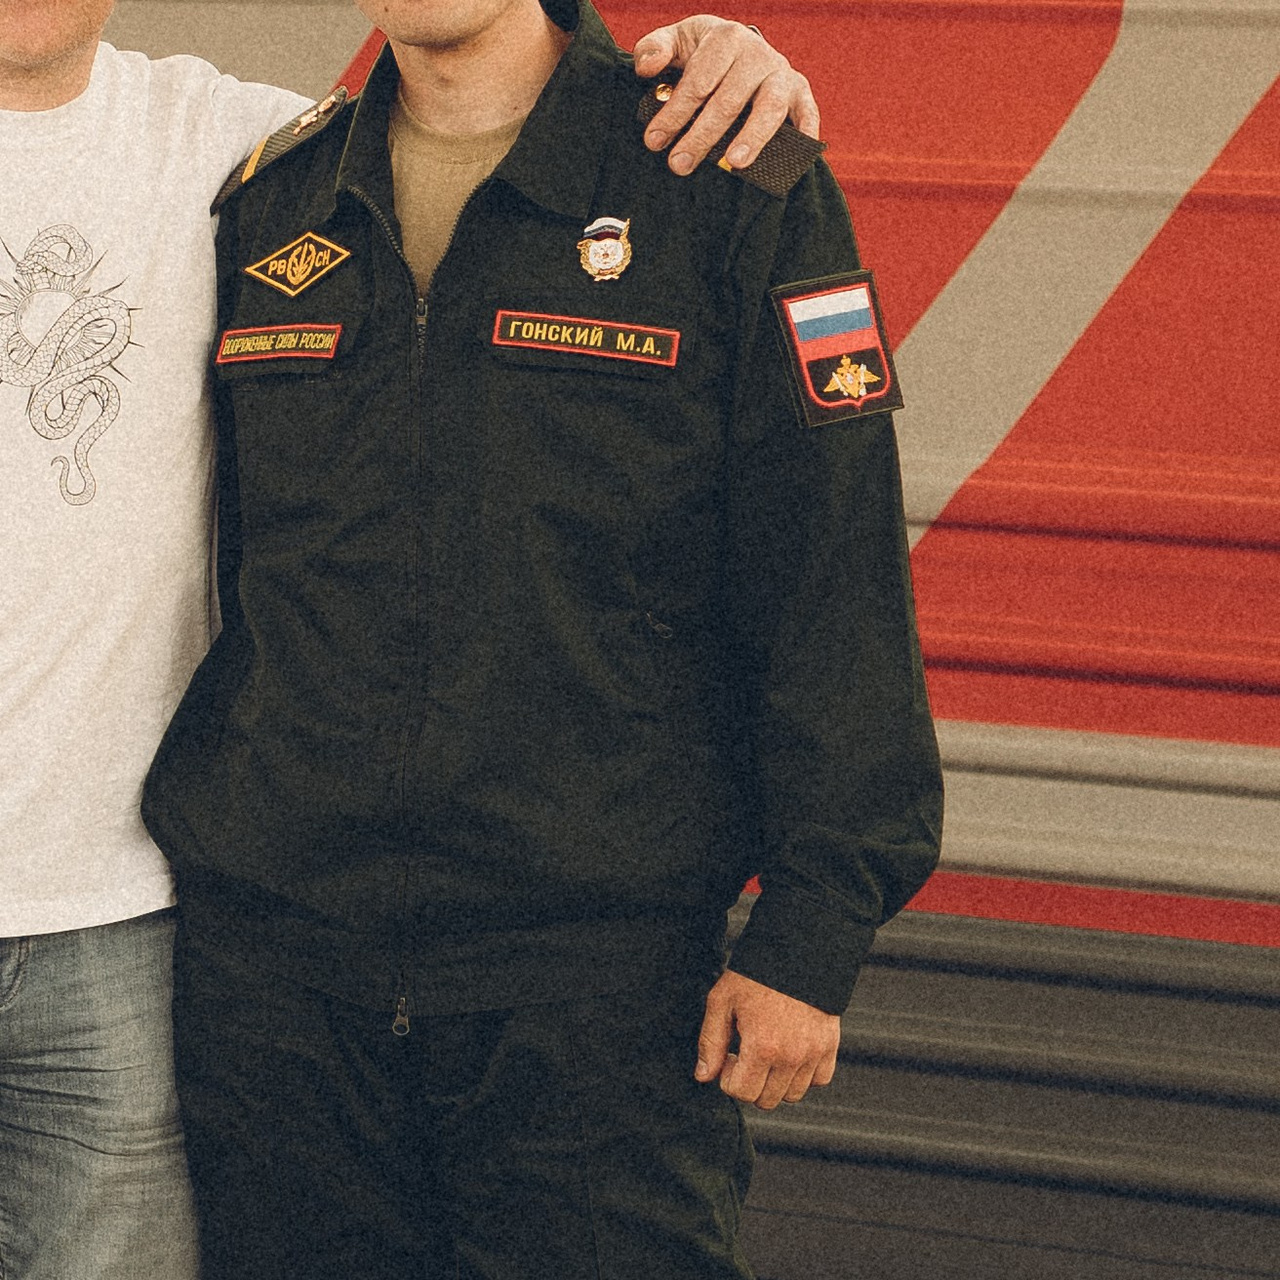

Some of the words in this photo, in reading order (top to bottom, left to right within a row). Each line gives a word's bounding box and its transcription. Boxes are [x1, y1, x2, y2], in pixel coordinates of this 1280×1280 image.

[299, 332, 336, 350] РОССИИ
[508, 321, 604, 347] ГОНСКИЙ
[616, 332, 662, 355] М.А.
